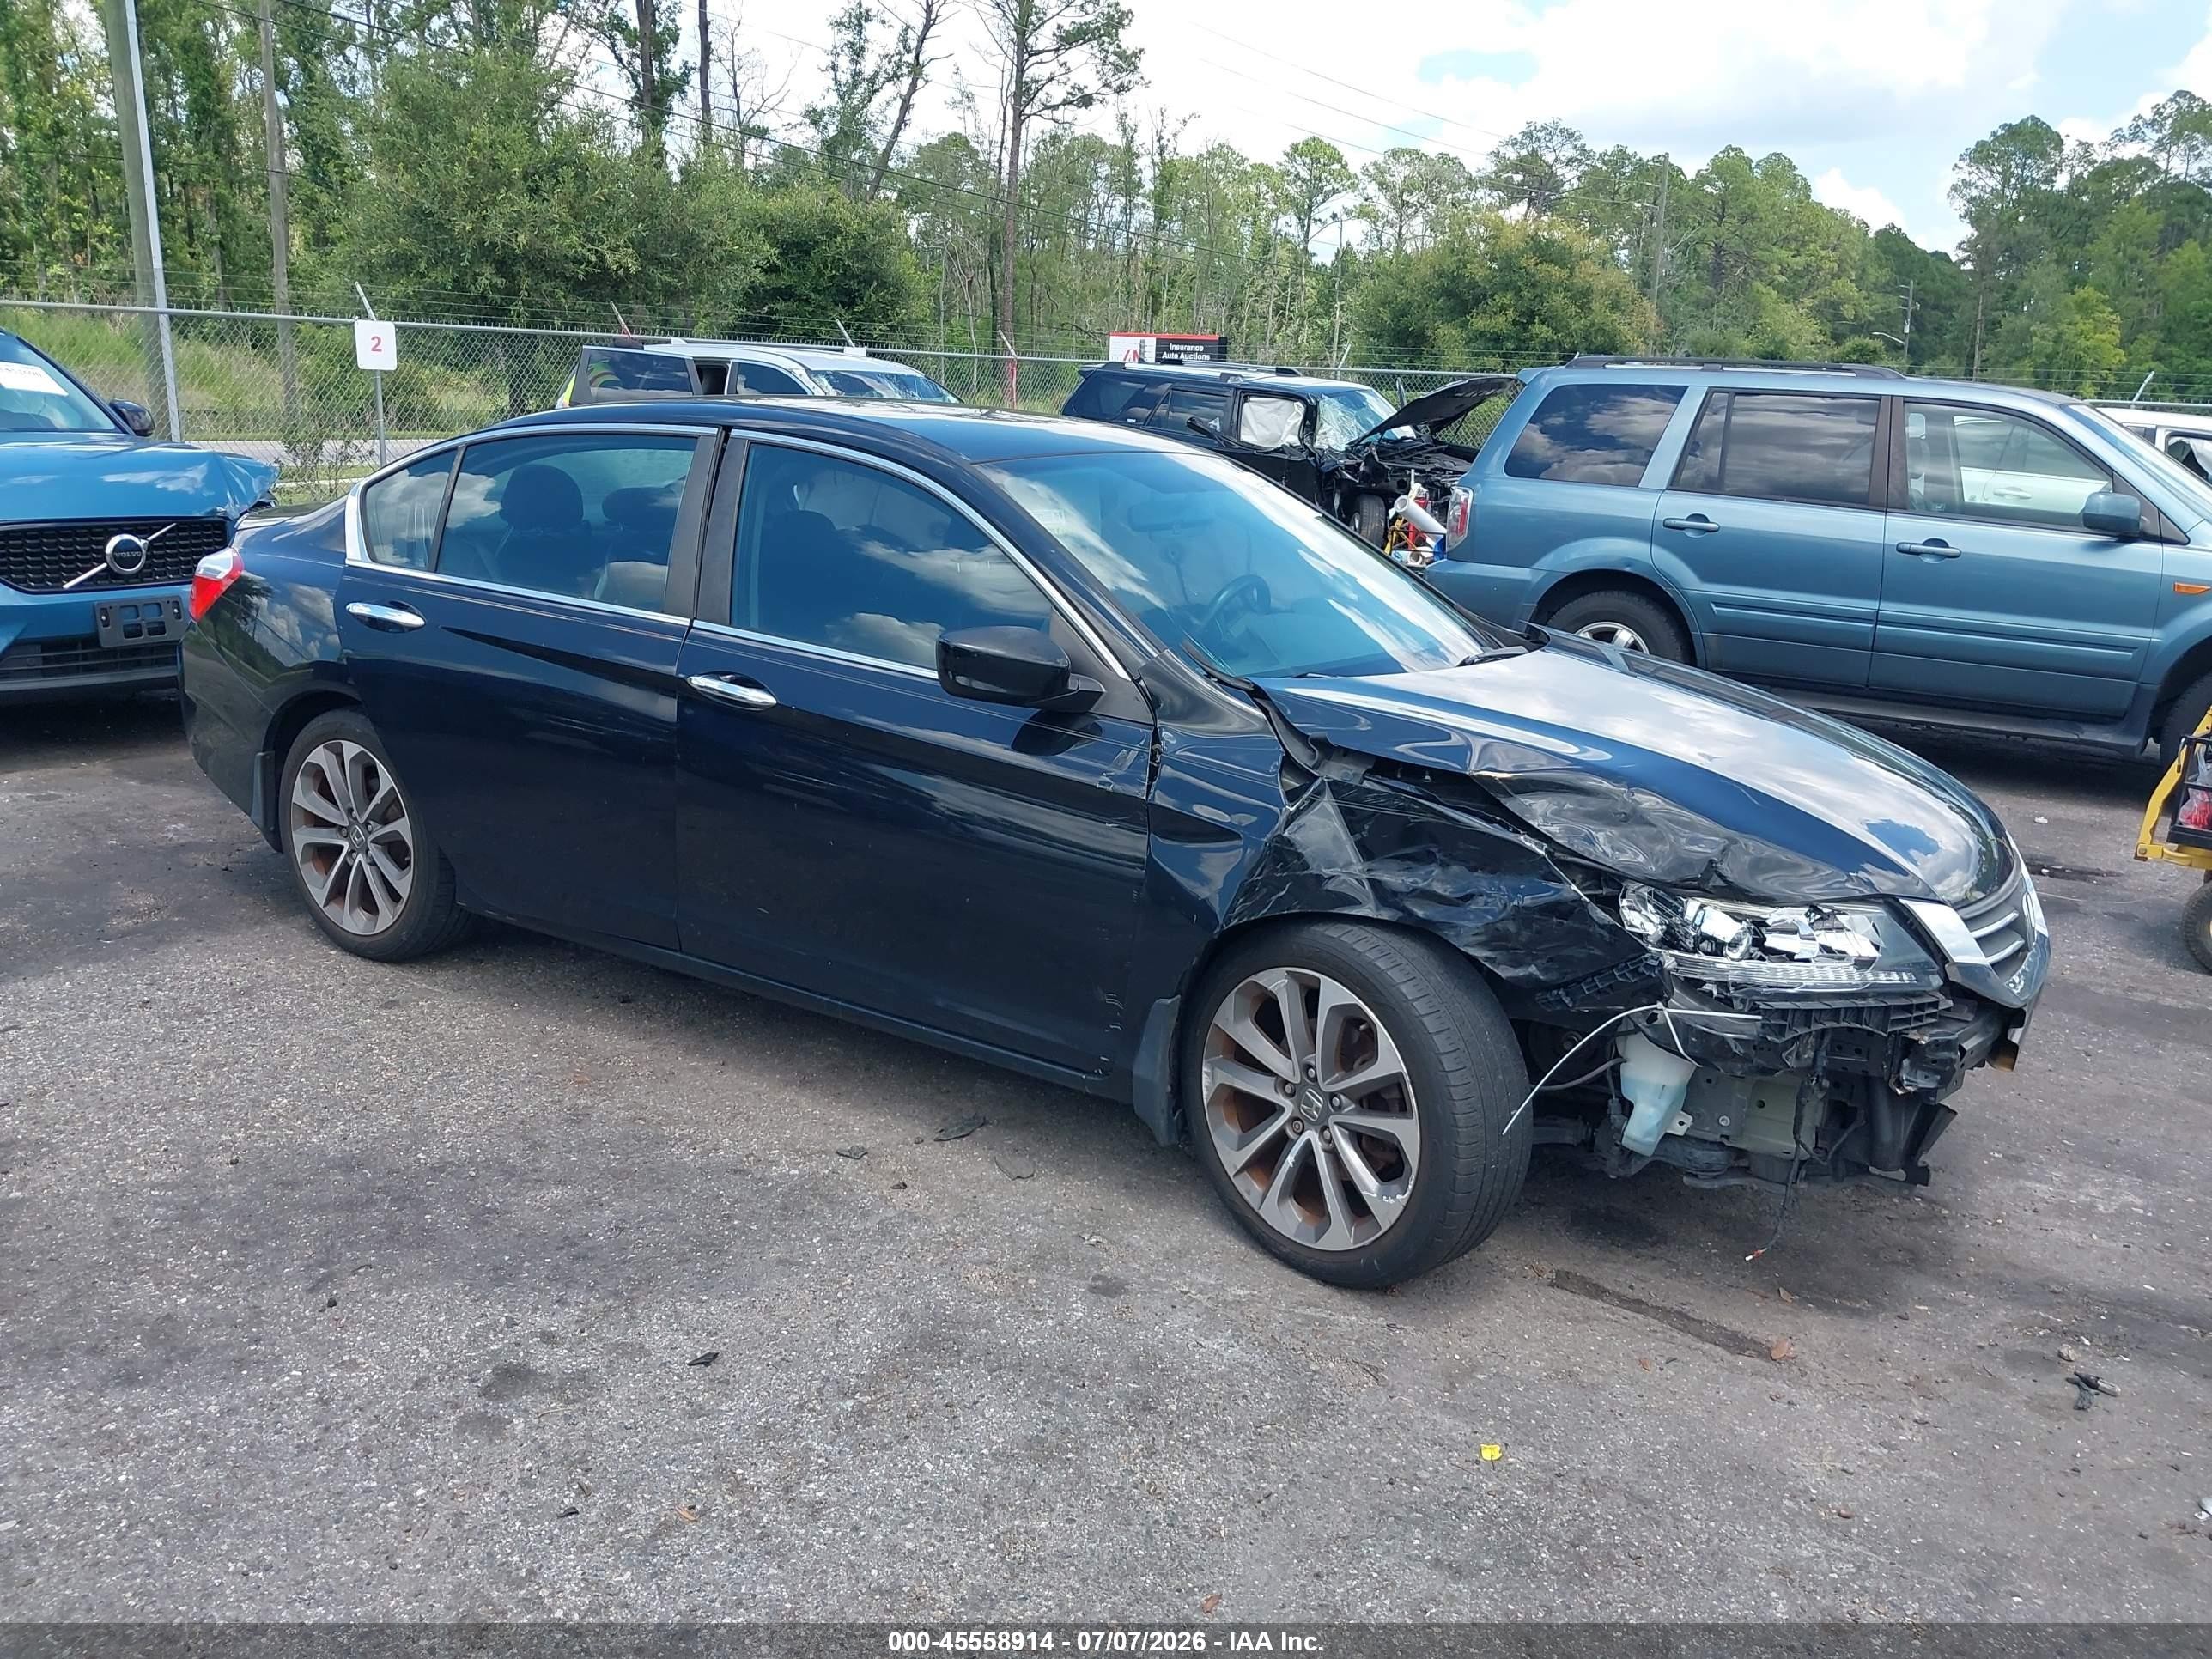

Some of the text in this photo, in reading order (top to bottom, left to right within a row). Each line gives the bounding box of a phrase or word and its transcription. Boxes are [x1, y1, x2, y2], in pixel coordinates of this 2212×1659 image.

[370, 336, 382, 352] 2
[1169, 343, 1204, 352] Insurance
[1180, 351, 1211, 361] Auctions
